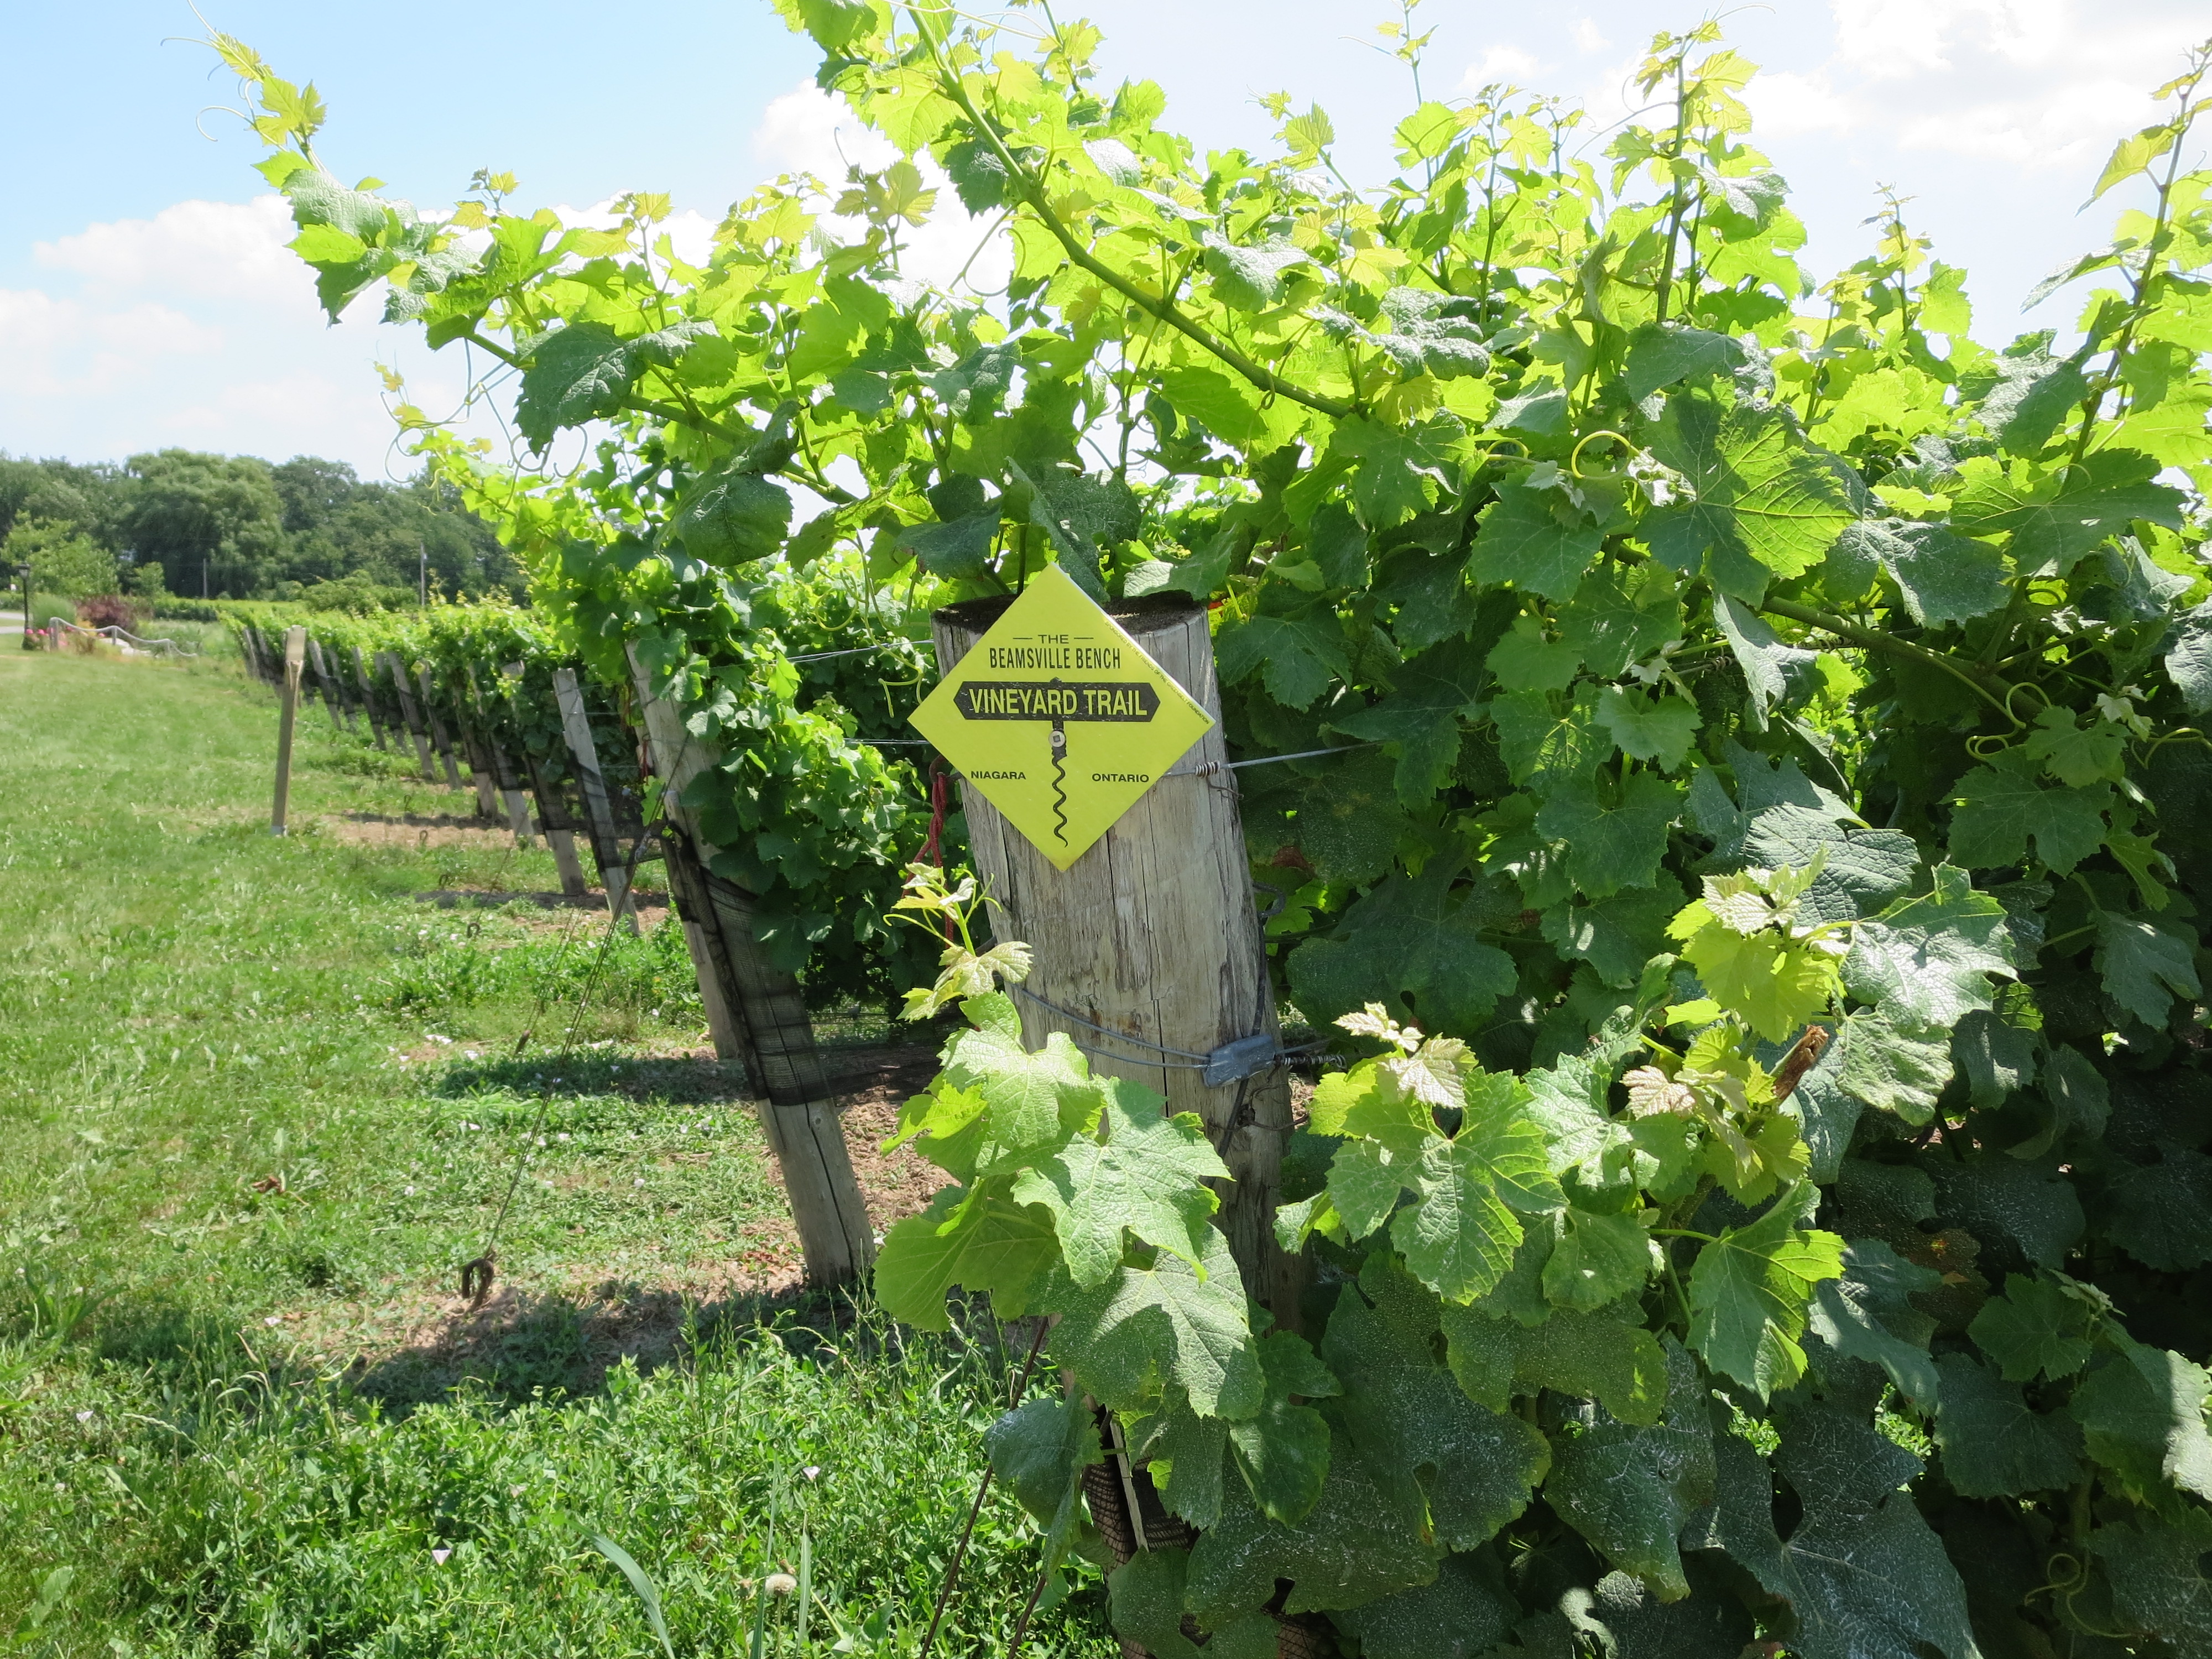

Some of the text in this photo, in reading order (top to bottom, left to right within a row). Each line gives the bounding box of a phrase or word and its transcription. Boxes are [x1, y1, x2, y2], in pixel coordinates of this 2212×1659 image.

[1038, 635, 1069, 644] THE
[990, 648, 1120, 669] BEAMSVILLE BENCH
[1104, 621, 1127, 643] SPONSORED
[1186, 701, 1209, 724] FOUNDATION
[969, 688, 1147, 715] VINEYARD TRAIL
[971, 771, 1026, 779] NIAGARA
[1092, 774, 1149, 782] ONTARIO
